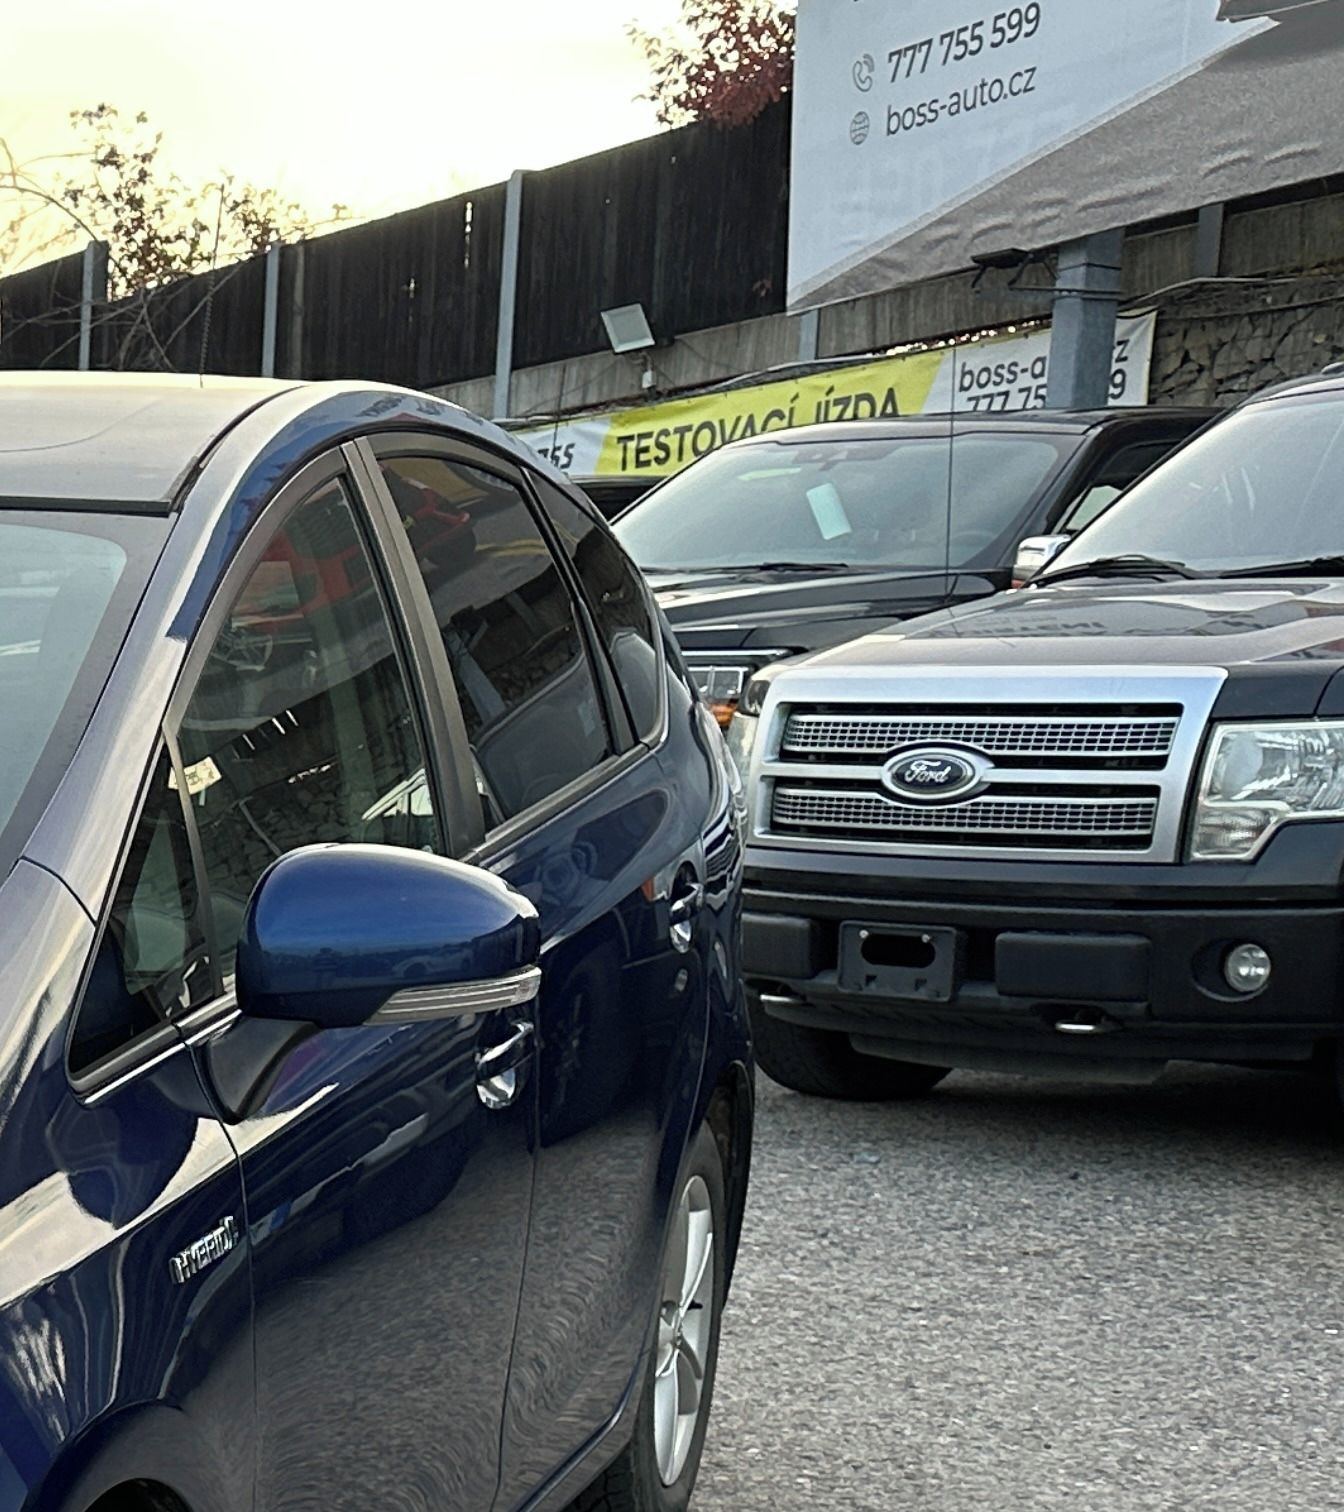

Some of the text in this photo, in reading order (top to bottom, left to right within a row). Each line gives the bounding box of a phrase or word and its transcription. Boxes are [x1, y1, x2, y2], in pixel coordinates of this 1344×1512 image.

[887, 1, 1041, 84] 777 755 599
[885, 66, 1038, 137] boss-auto.cz
[616, 392, 800, 472] TESTOVACÍ
[904, 760, 952, 783] Ford
